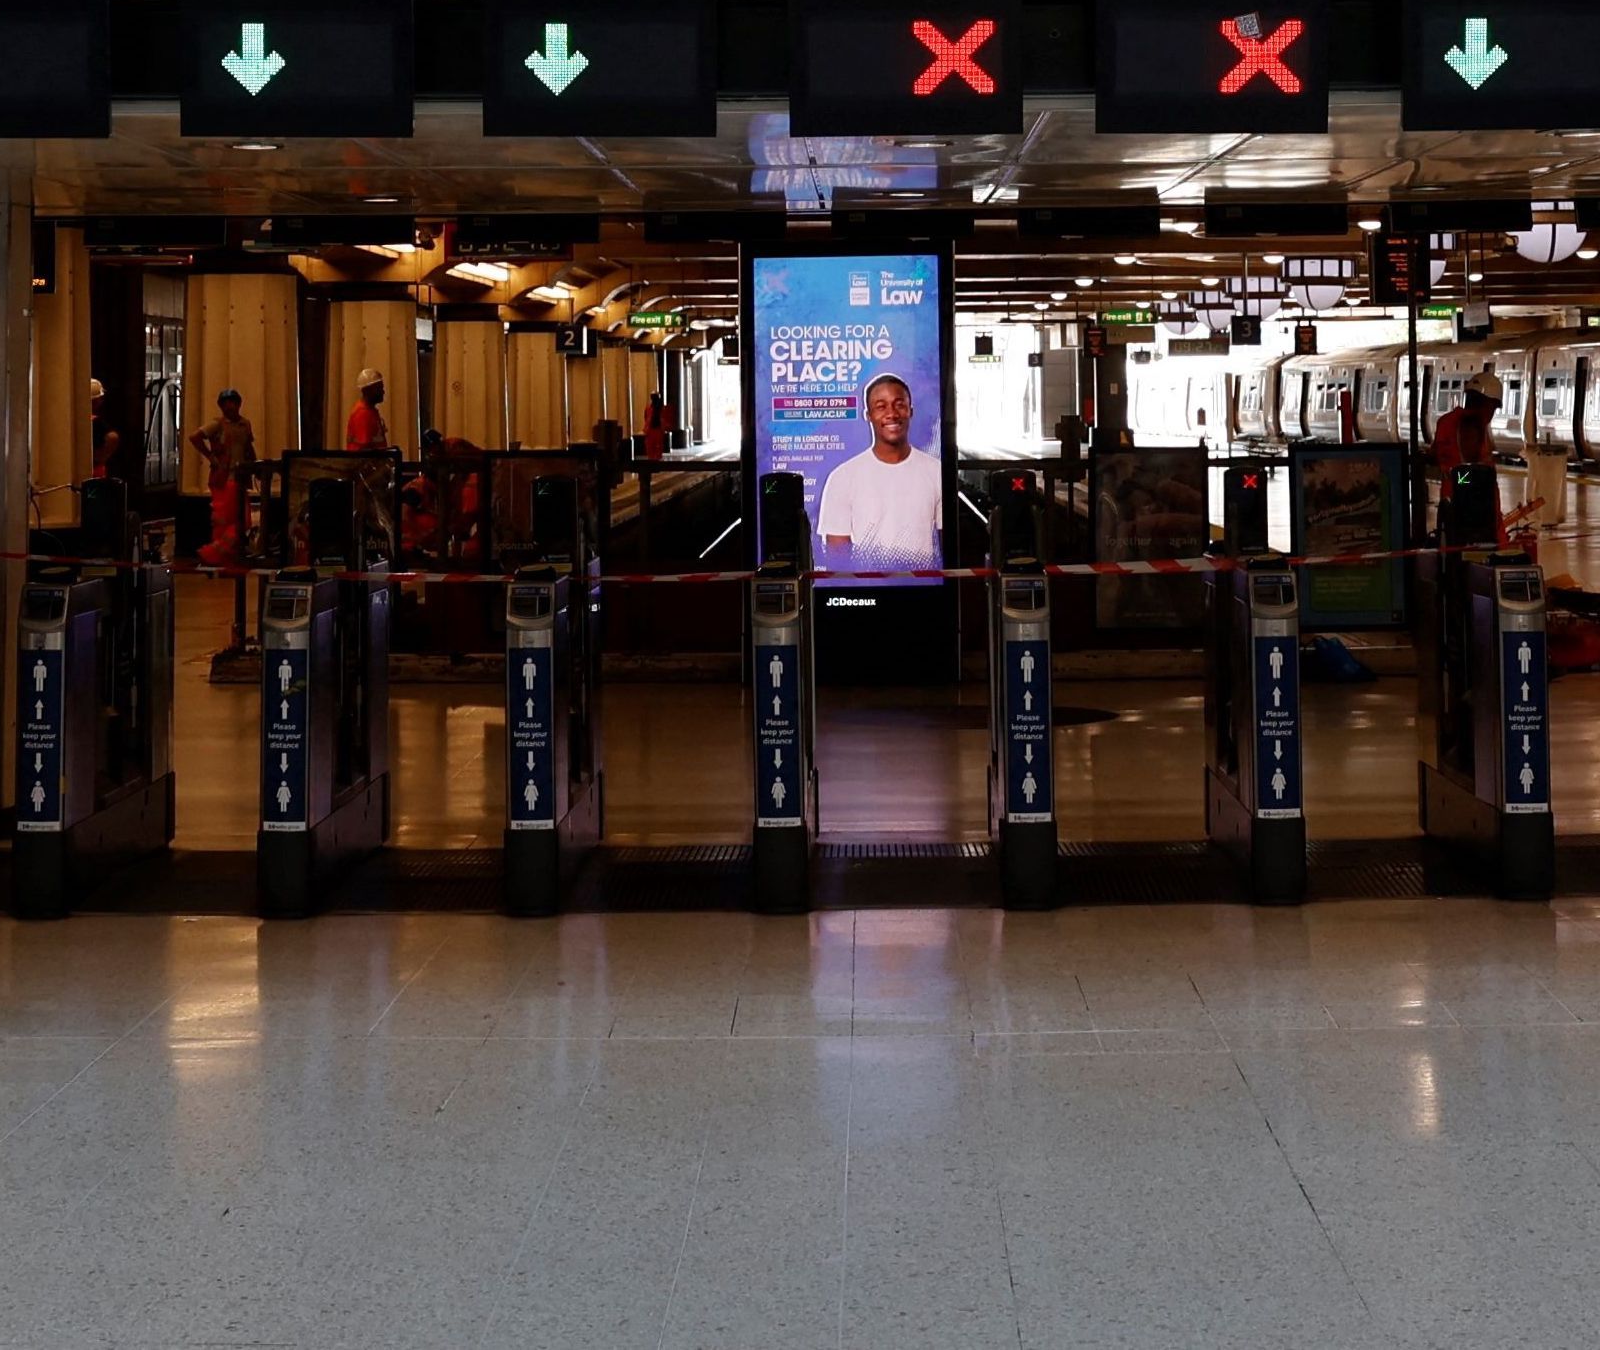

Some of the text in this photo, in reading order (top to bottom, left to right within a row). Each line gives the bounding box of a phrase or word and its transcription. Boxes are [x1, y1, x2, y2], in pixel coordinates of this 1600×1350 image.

[881, 287, 923, 305] Law
[630, 316, 662, 324] Fire exit
[771, 324, 890, 340] LOOKING FOR A
[1241, 323, 1253, 337] 3
[564, 331, 575, 346] 2
[769, 339, 893, 361] CLEARING
[771, 361, 862, 383] PLACE?
[800, 384, 821, 393] HERE
[823, 383, 836, 392] TO
[837, 383, 858, 392] HELP
[826, 597, 877, 607] JCDecaux
[766, 718, 790, 727] Please
